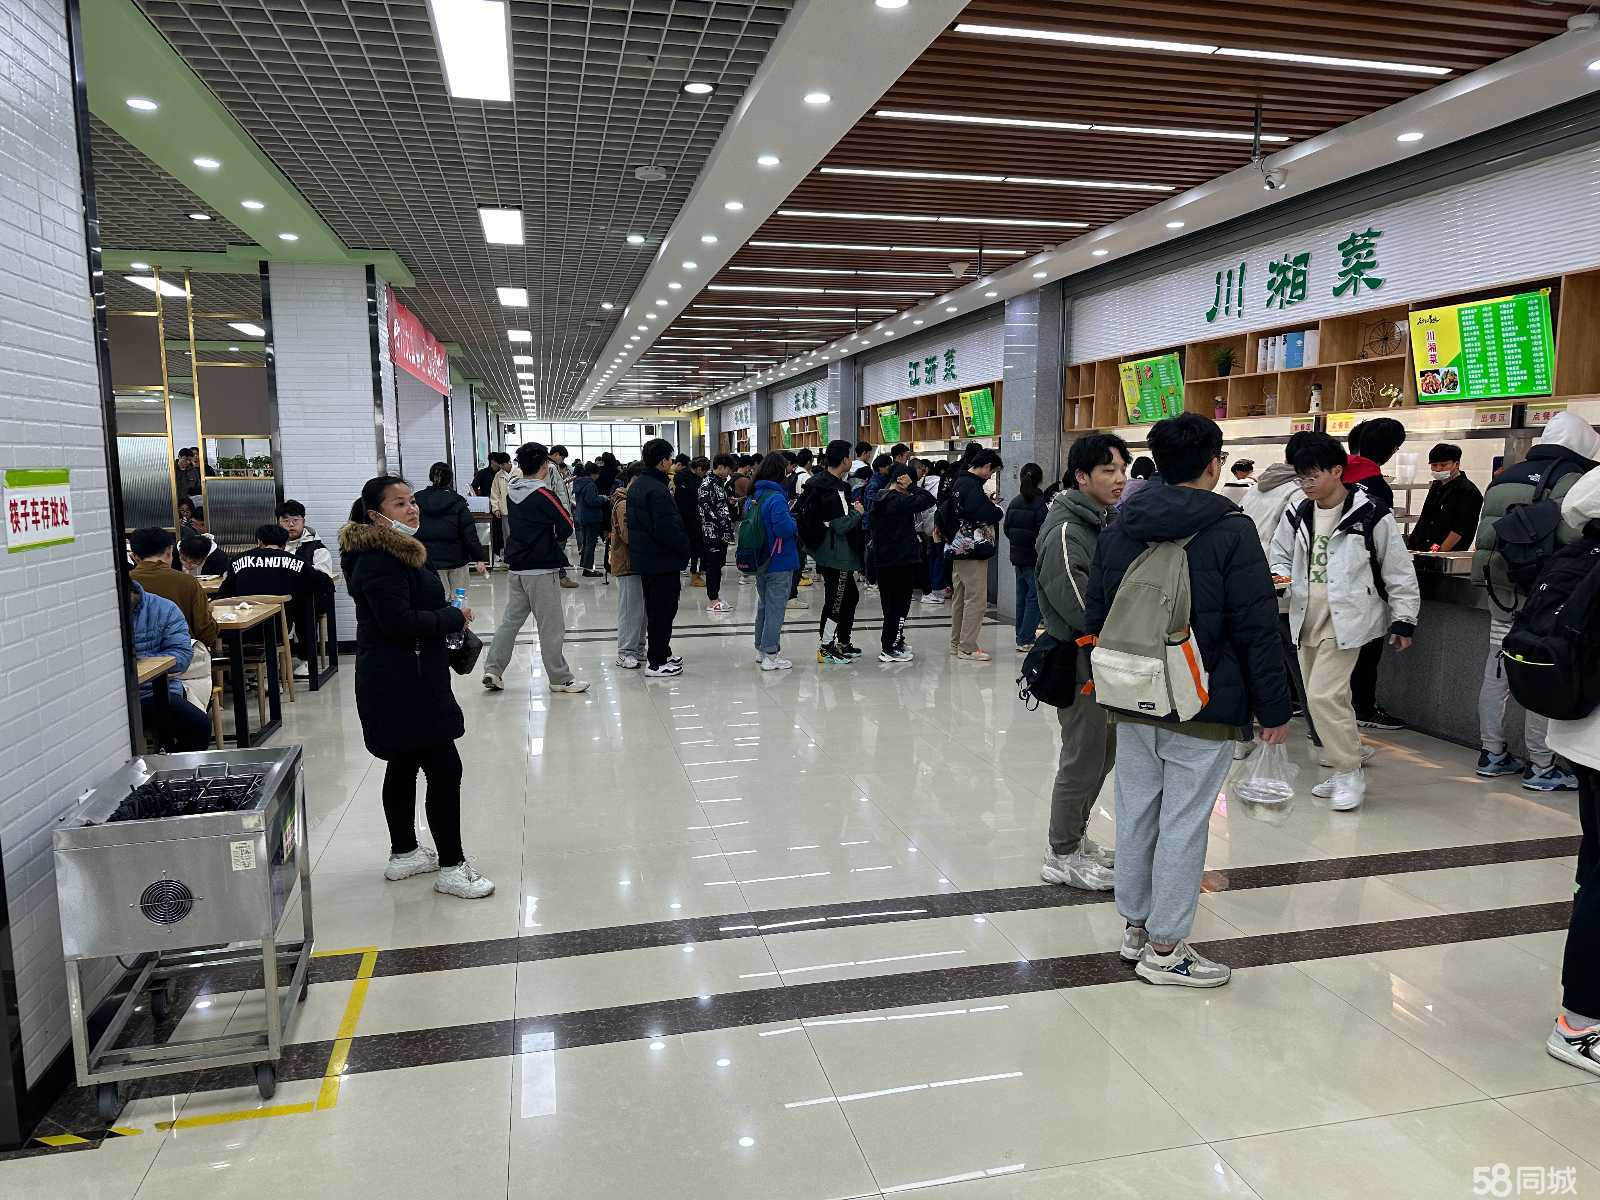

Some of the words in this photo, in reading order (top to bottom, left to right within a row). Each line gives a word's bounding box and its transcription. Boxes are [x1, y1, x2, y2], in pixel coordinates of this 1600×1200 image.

[1205, 228, 1384, 323] 川湘菜
[908, 348, 957, 386] 江浙菜
[9, 495, 70, 534] 筷子车存放处
